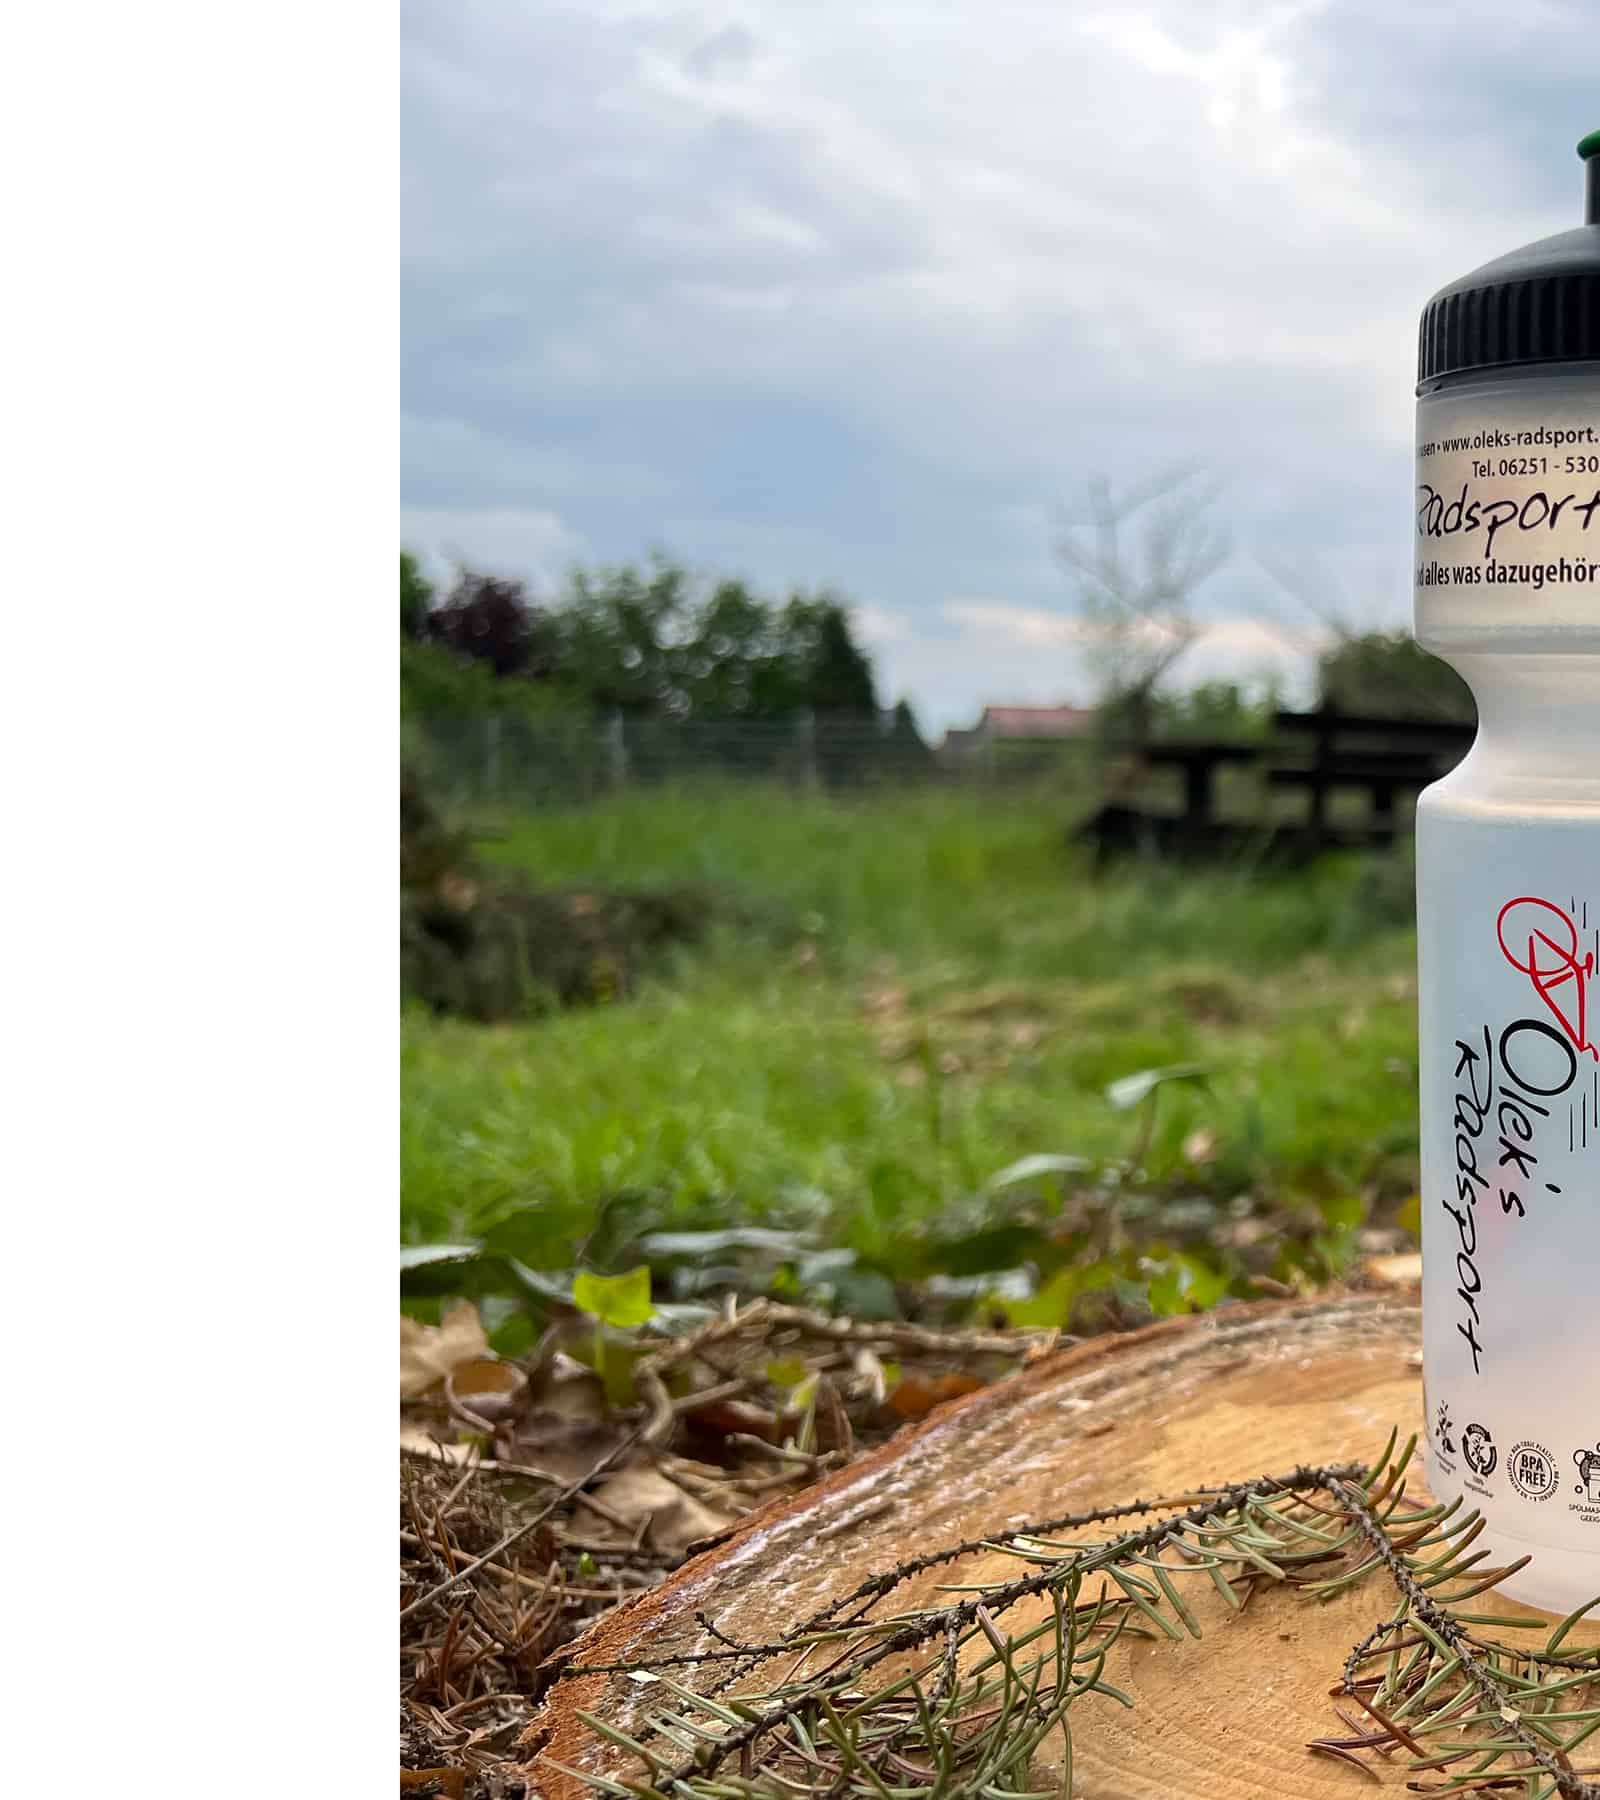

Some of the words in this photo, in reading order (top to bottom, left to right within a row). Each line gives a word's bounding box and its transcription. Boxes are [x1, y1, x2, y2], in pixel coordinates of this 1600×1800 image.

[1471, 459, 1496, 478] Tel.
[1498, 456, 1548, 476] 06251
[1425, 560, 1450, 586] alles
[1452, 565, 1482, 584] was
[1499, 1018, 1578, 1218] Olek's
[1442, 1024, 1493, 1375] Radsport
[1521, 1453, 1544, 1472] BPA
[1519, 1468, 1546, 1488] FREE
